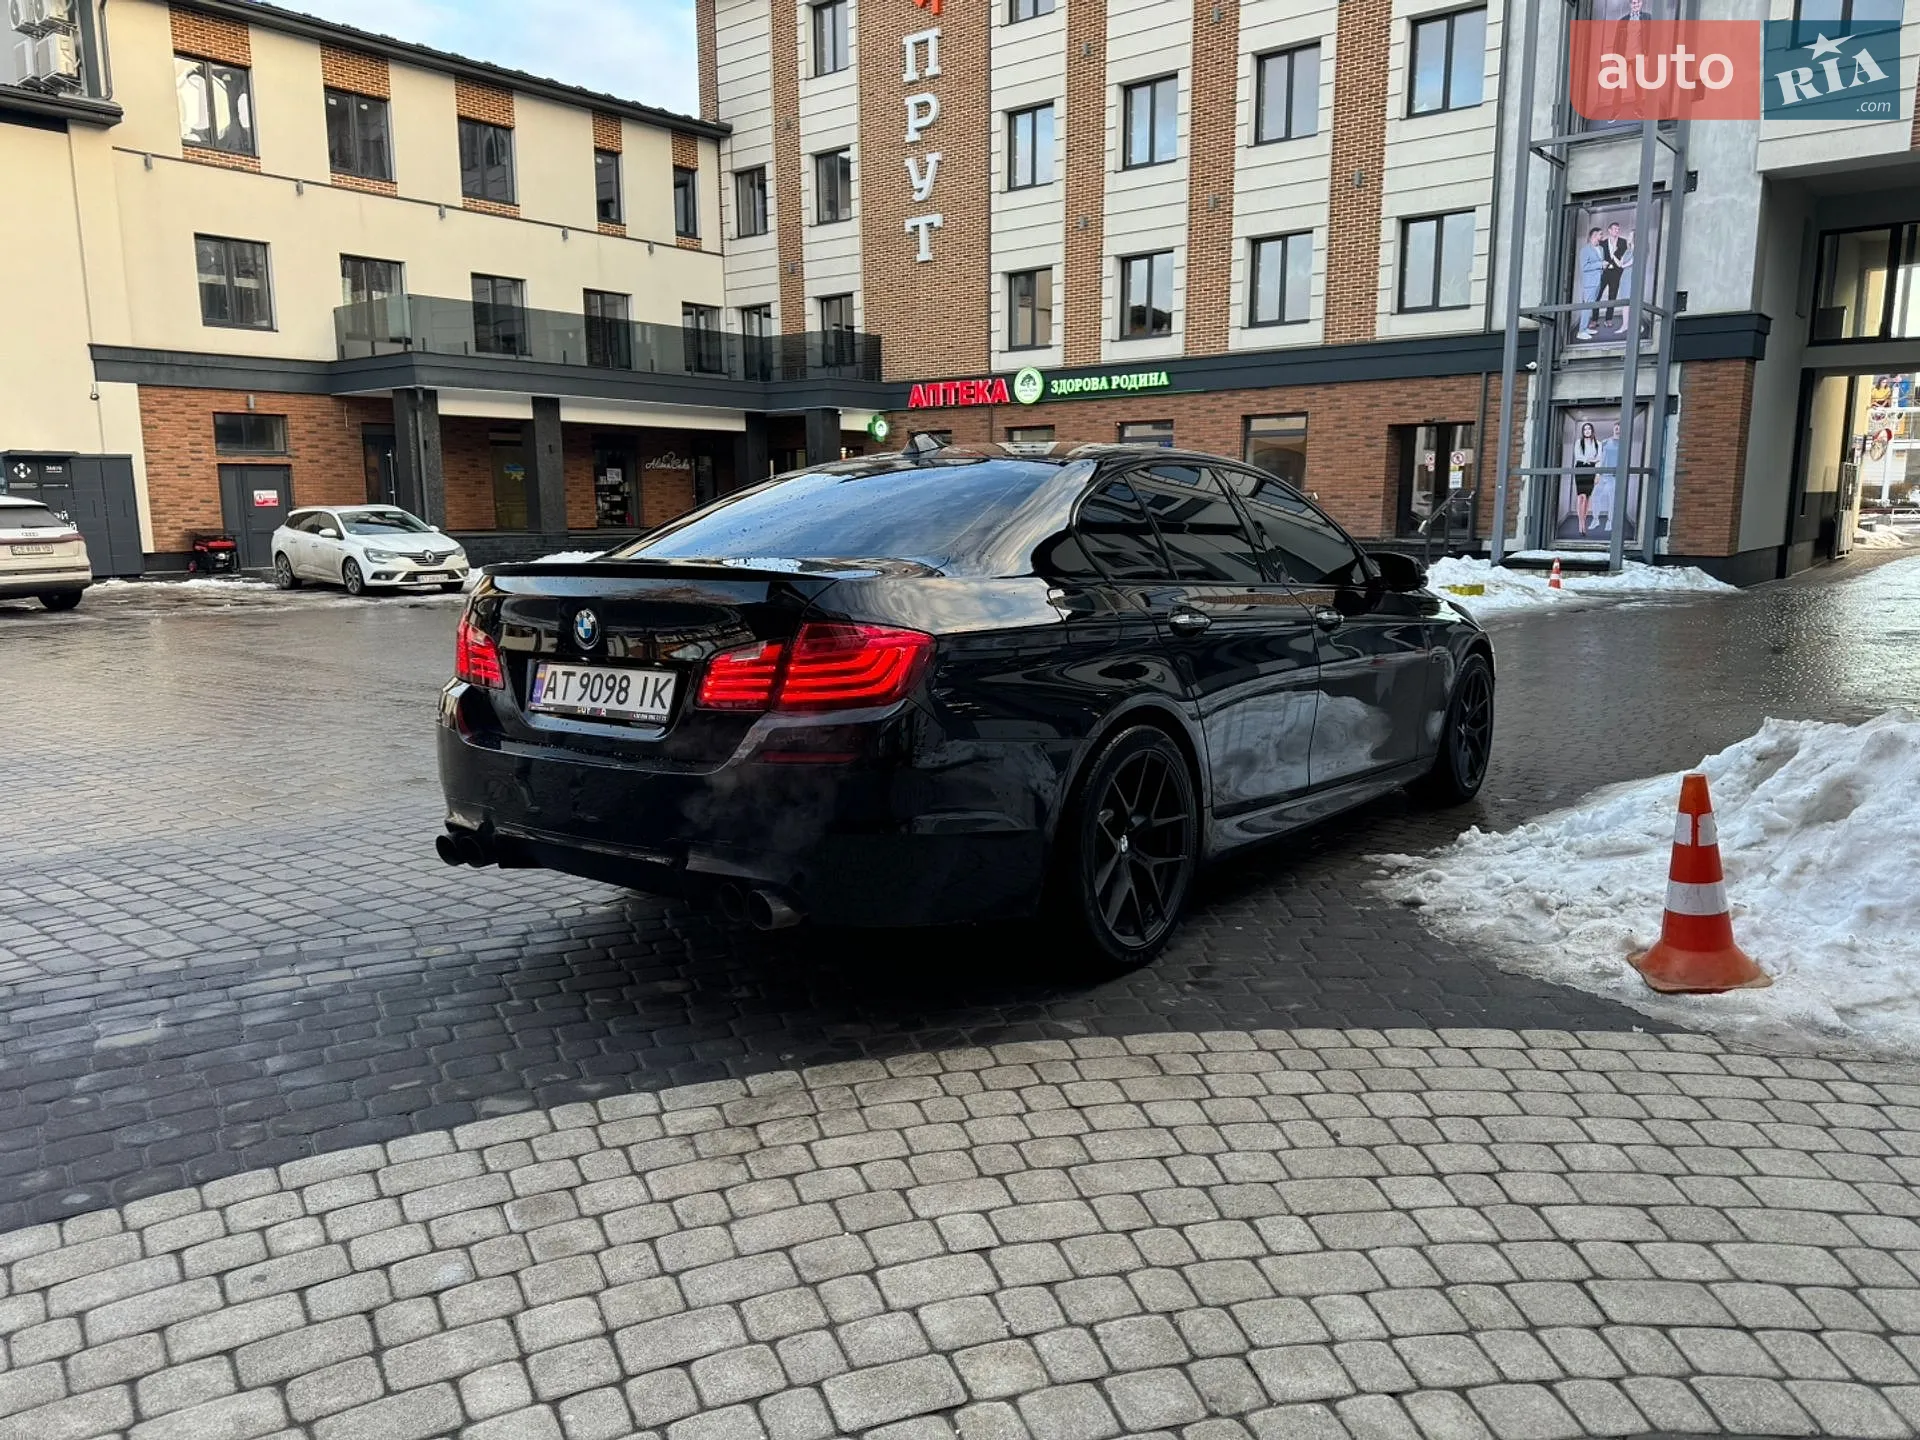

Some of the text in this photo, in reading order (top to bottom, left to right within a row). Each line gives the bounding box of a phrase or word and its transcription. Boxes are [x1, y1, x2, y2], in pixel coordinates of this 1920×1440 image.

[902, 27, 944, 263] ПРУТ
[907, 377, 1011, 408] АПТЕКА
[1050, 376, 1109, 395] ЗДОРОВА
[1111, 371, 1169, 391] РОДИНА
[639, 676, 672, 709] IK
